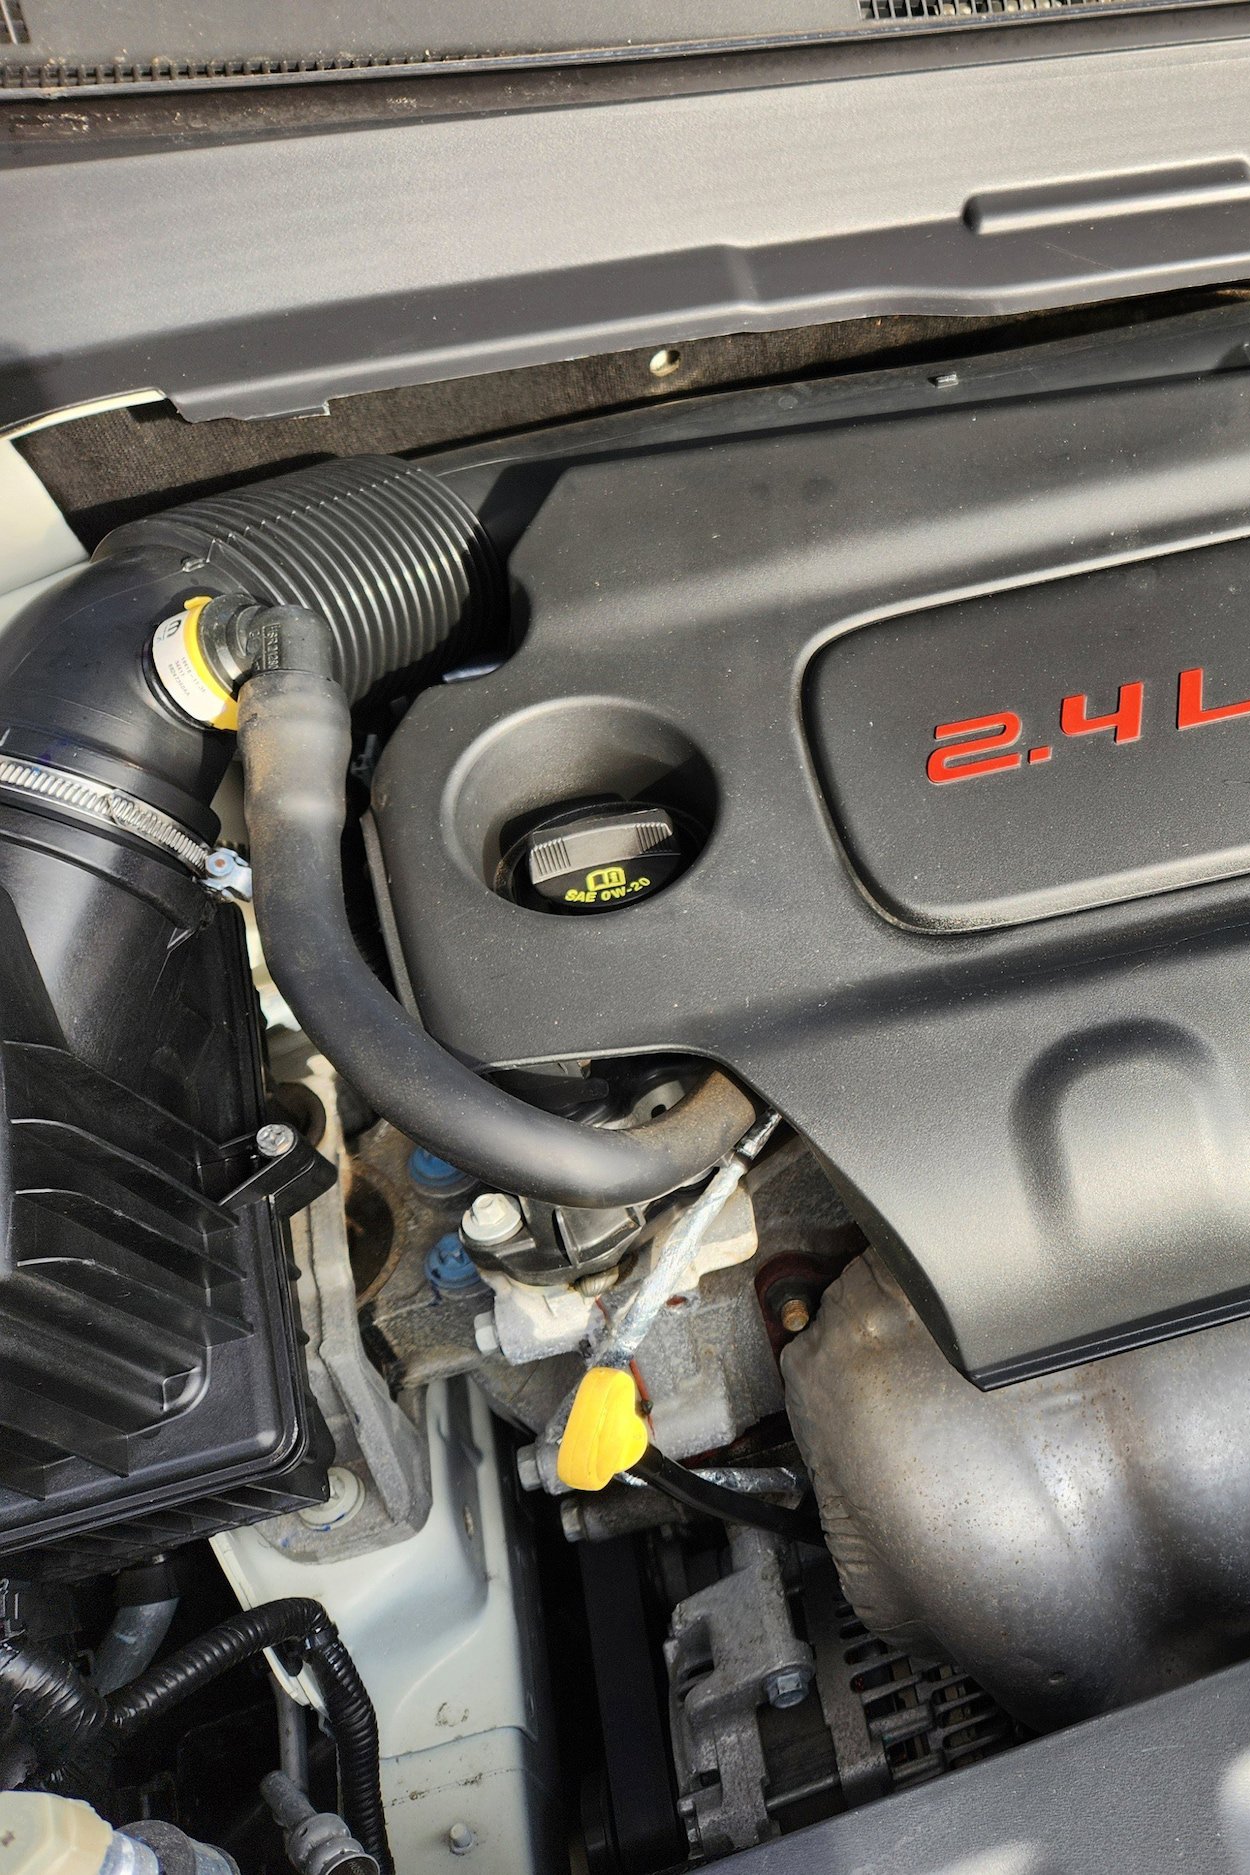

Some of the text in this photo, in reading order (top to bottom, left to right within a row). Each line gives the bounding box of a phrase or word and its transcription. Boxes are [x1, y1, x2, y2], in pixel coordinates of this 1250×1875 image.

[927, 681, 1144, 785] 2.4
[564, 877, 651, 903] SAE 0W-20
